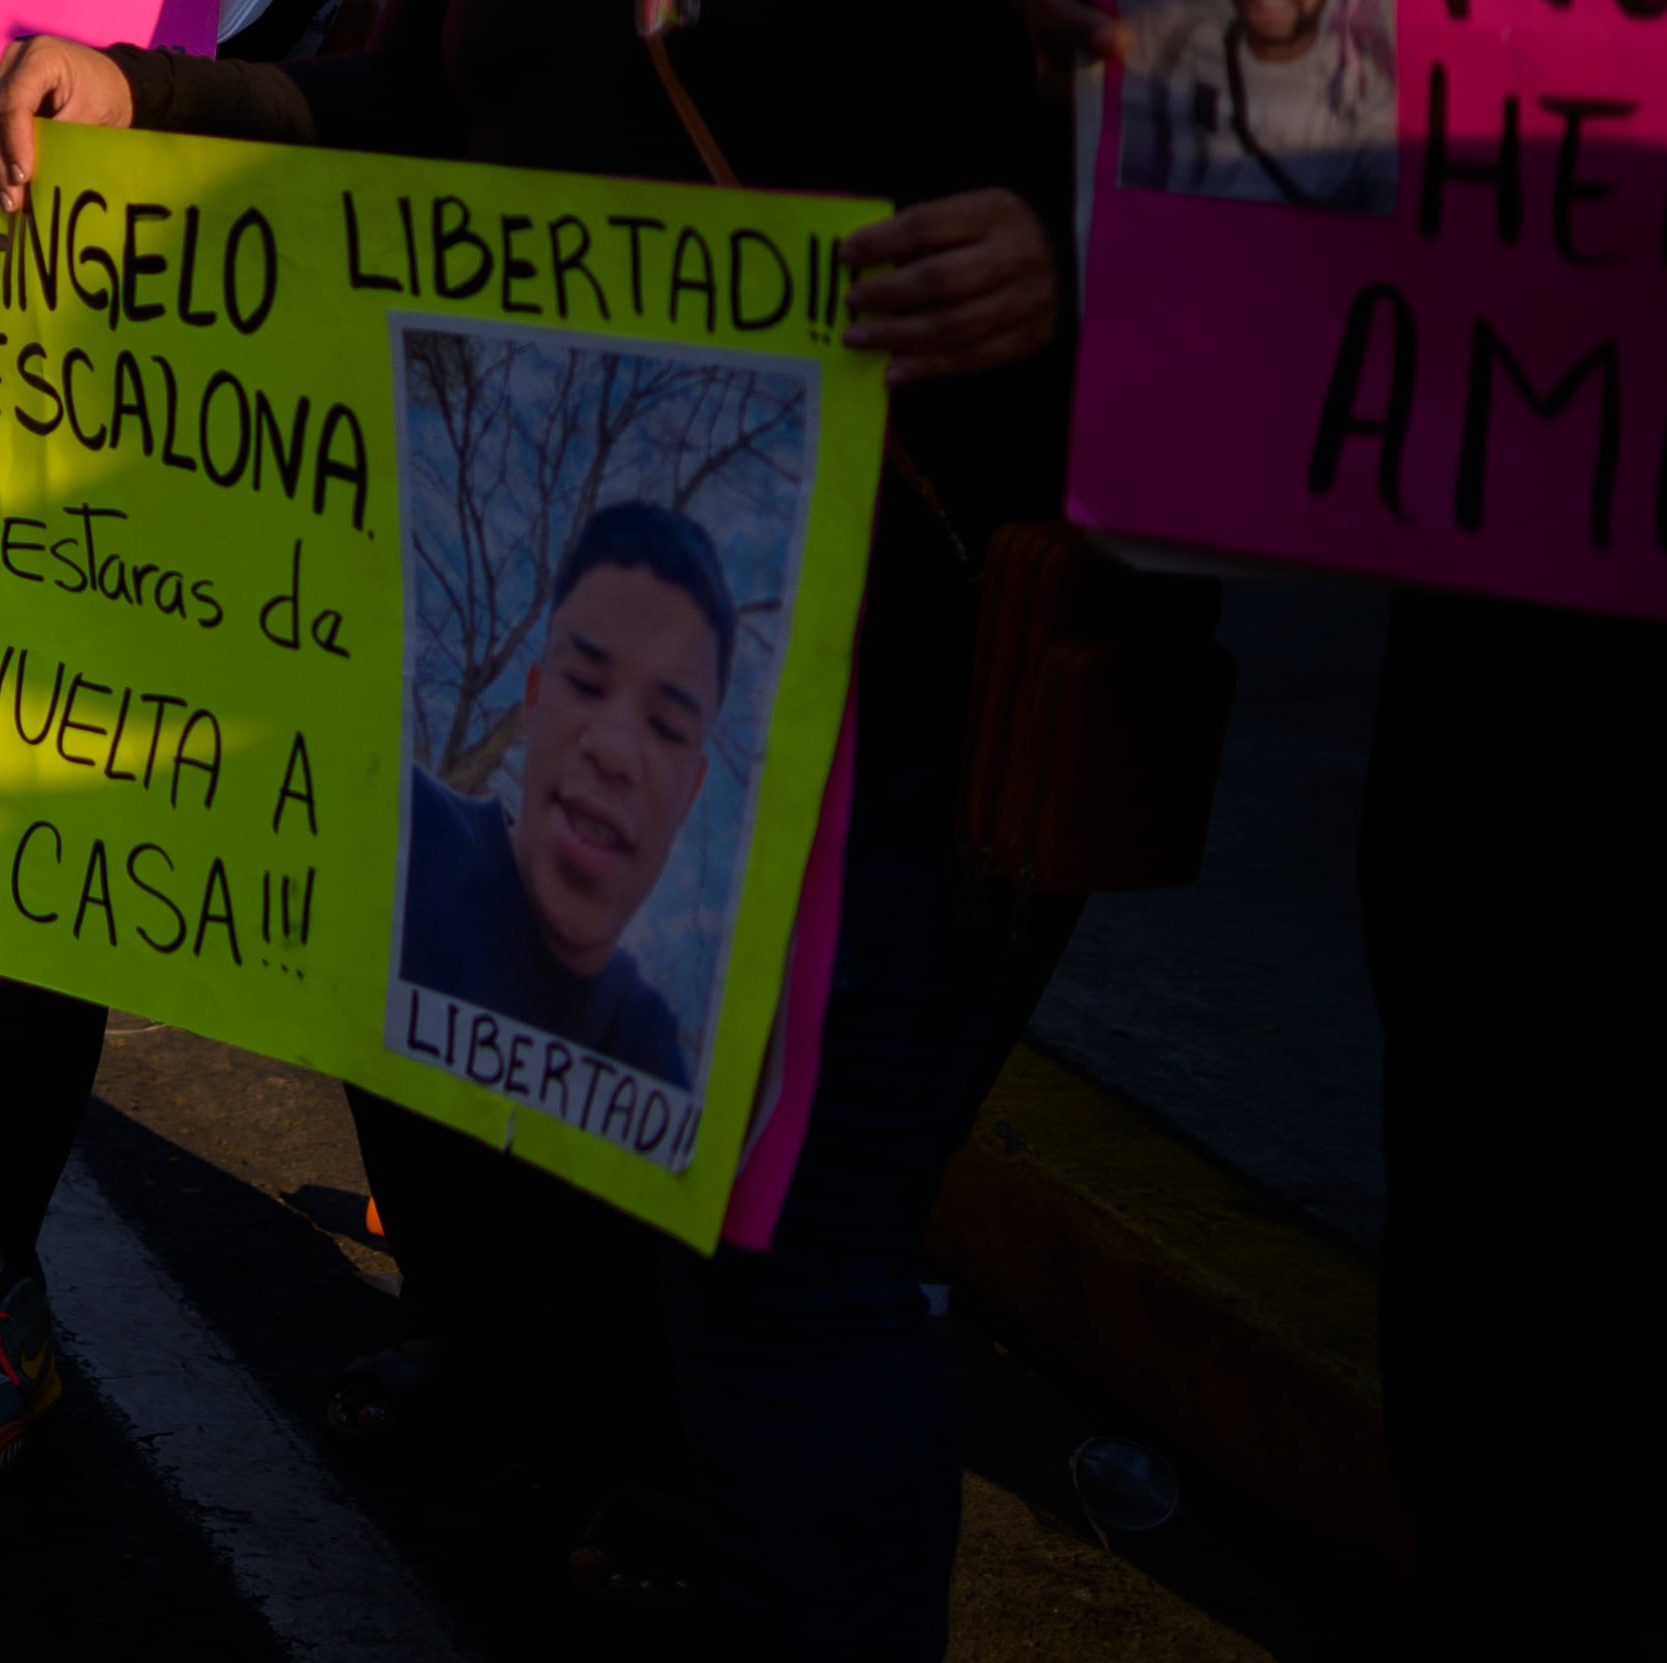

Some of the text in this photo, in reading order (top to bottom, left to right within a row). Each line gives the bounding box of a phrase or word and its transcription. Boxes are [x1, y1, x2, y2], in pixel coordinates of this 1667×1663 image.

[1417, 60, 1667, 269] HE
[343, 189, 861, 348] LIBERTAD!!
[1307, 282, 1667, 554] AM
[1, 501, 352, 661] Estaras de
[273, 731, 320, 838] A
[10, 819, 316, 984] CASA!!!
